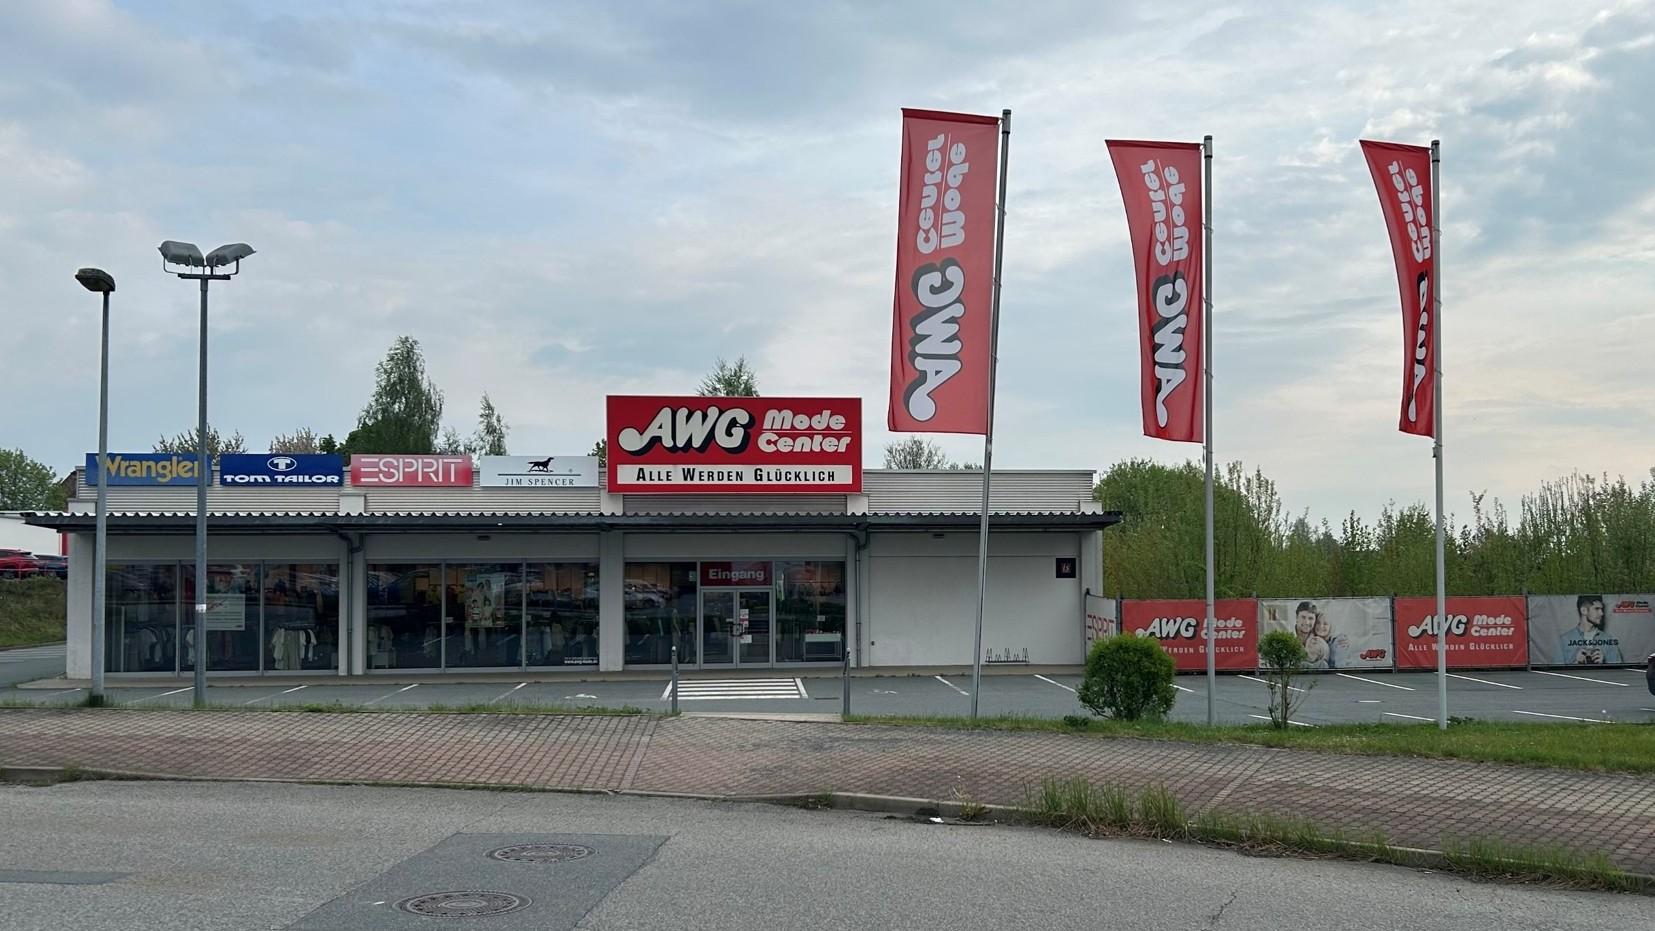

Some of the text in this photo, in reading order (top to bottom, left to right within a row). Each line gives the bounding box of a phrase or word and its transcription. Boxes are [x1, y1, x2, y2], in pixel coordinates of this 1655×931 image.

[763, 409, 846, 430] Mode
[617, 406, 751, 452] AWG
[757, 432, 852, 453] Center
[360, 457, 463, 483] ESPRIT
[636, 467, 836, 482] ALLE WERDEN GLÜCKLICH
[224, 475, 340, 483] TOM TAILOR
[505, 478, 574, 486] JIM SPENCER
[709, 568, 765, 581] Eingang
[1473, 614, 1512, 625] Mode
[1135, 616, 1197, 639] AWG
[1471, 625, 1515, 637] Center
[1199, 645, 1245, 653] GLCKLICH
[1408, 642, 1514, 651] ALLE WRDEN GLÜCKLICH
